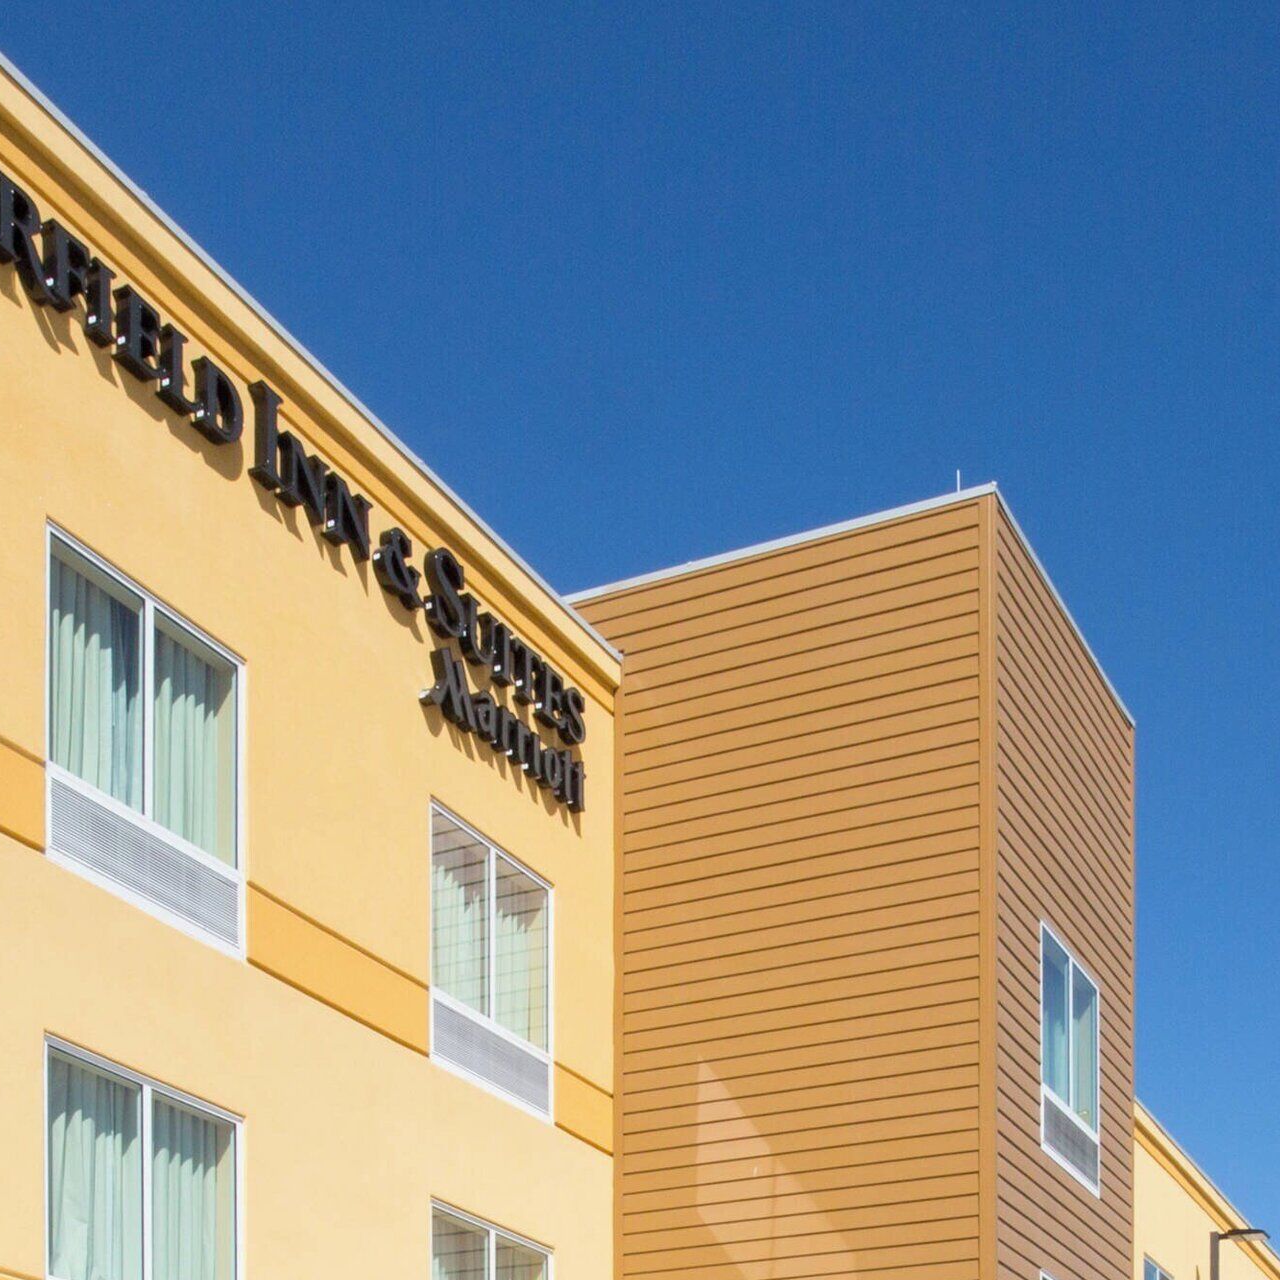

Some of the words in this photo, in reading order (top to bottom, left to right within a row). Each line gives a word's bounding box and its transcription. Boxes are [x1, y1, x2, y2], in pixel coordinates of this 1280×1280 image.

[247, 379, 373, 562] INN
[372, 527, 424, 612] &
[423, 547, 586, 745] SUITES
[419, 648, 587, 813] Marriott
